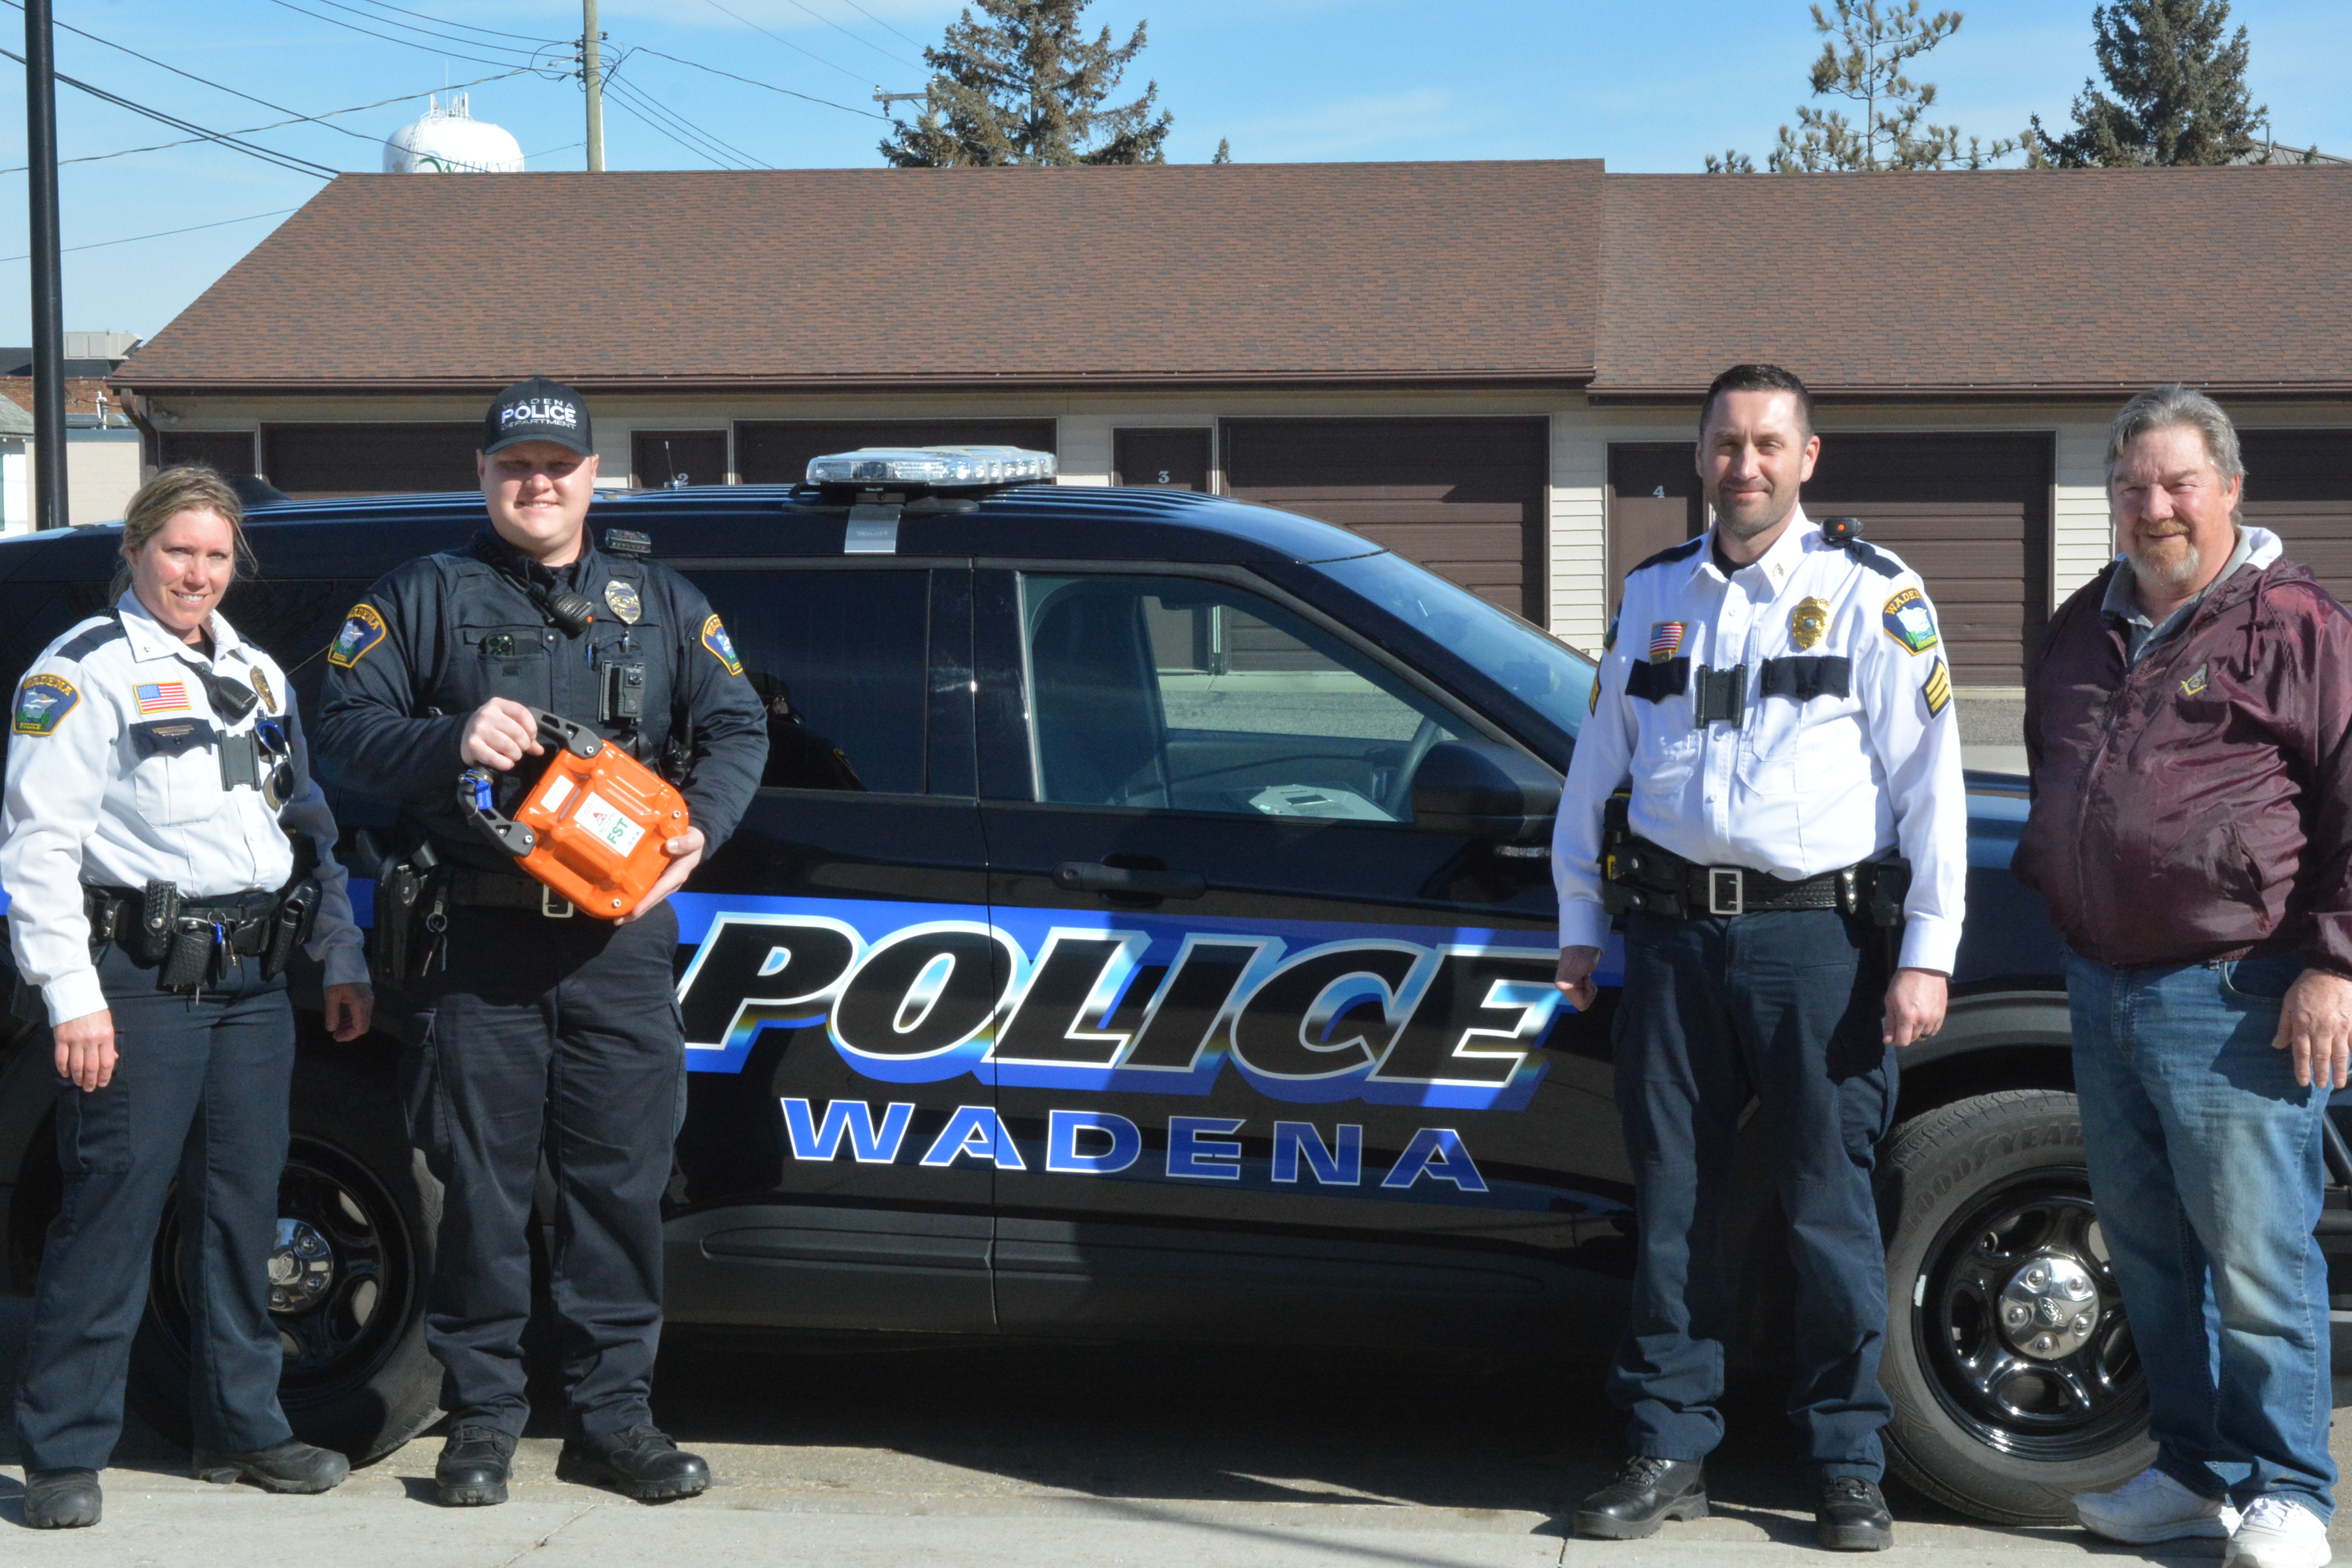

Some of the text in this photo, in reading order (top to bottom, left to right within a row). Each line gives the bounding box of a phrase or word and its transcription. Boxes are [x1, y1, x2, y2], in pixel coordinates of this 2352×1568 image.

[502, 398, 574, 410] WADENA
[501, 404, 576, 424] POLICE
[501, 419, 576, 431] DEPARTMENT
[678, 472, 689, 485] 2
[1158, 470, 1169, 483] 3
[1653, 485, 1665, 498] 4
[23, 676, 72, 696] WADENA
[606, 817, 629, 845] FST
[677, 911, 1563, 1091] POLICE
[780, 1096, 1490, 1192] WADENA
